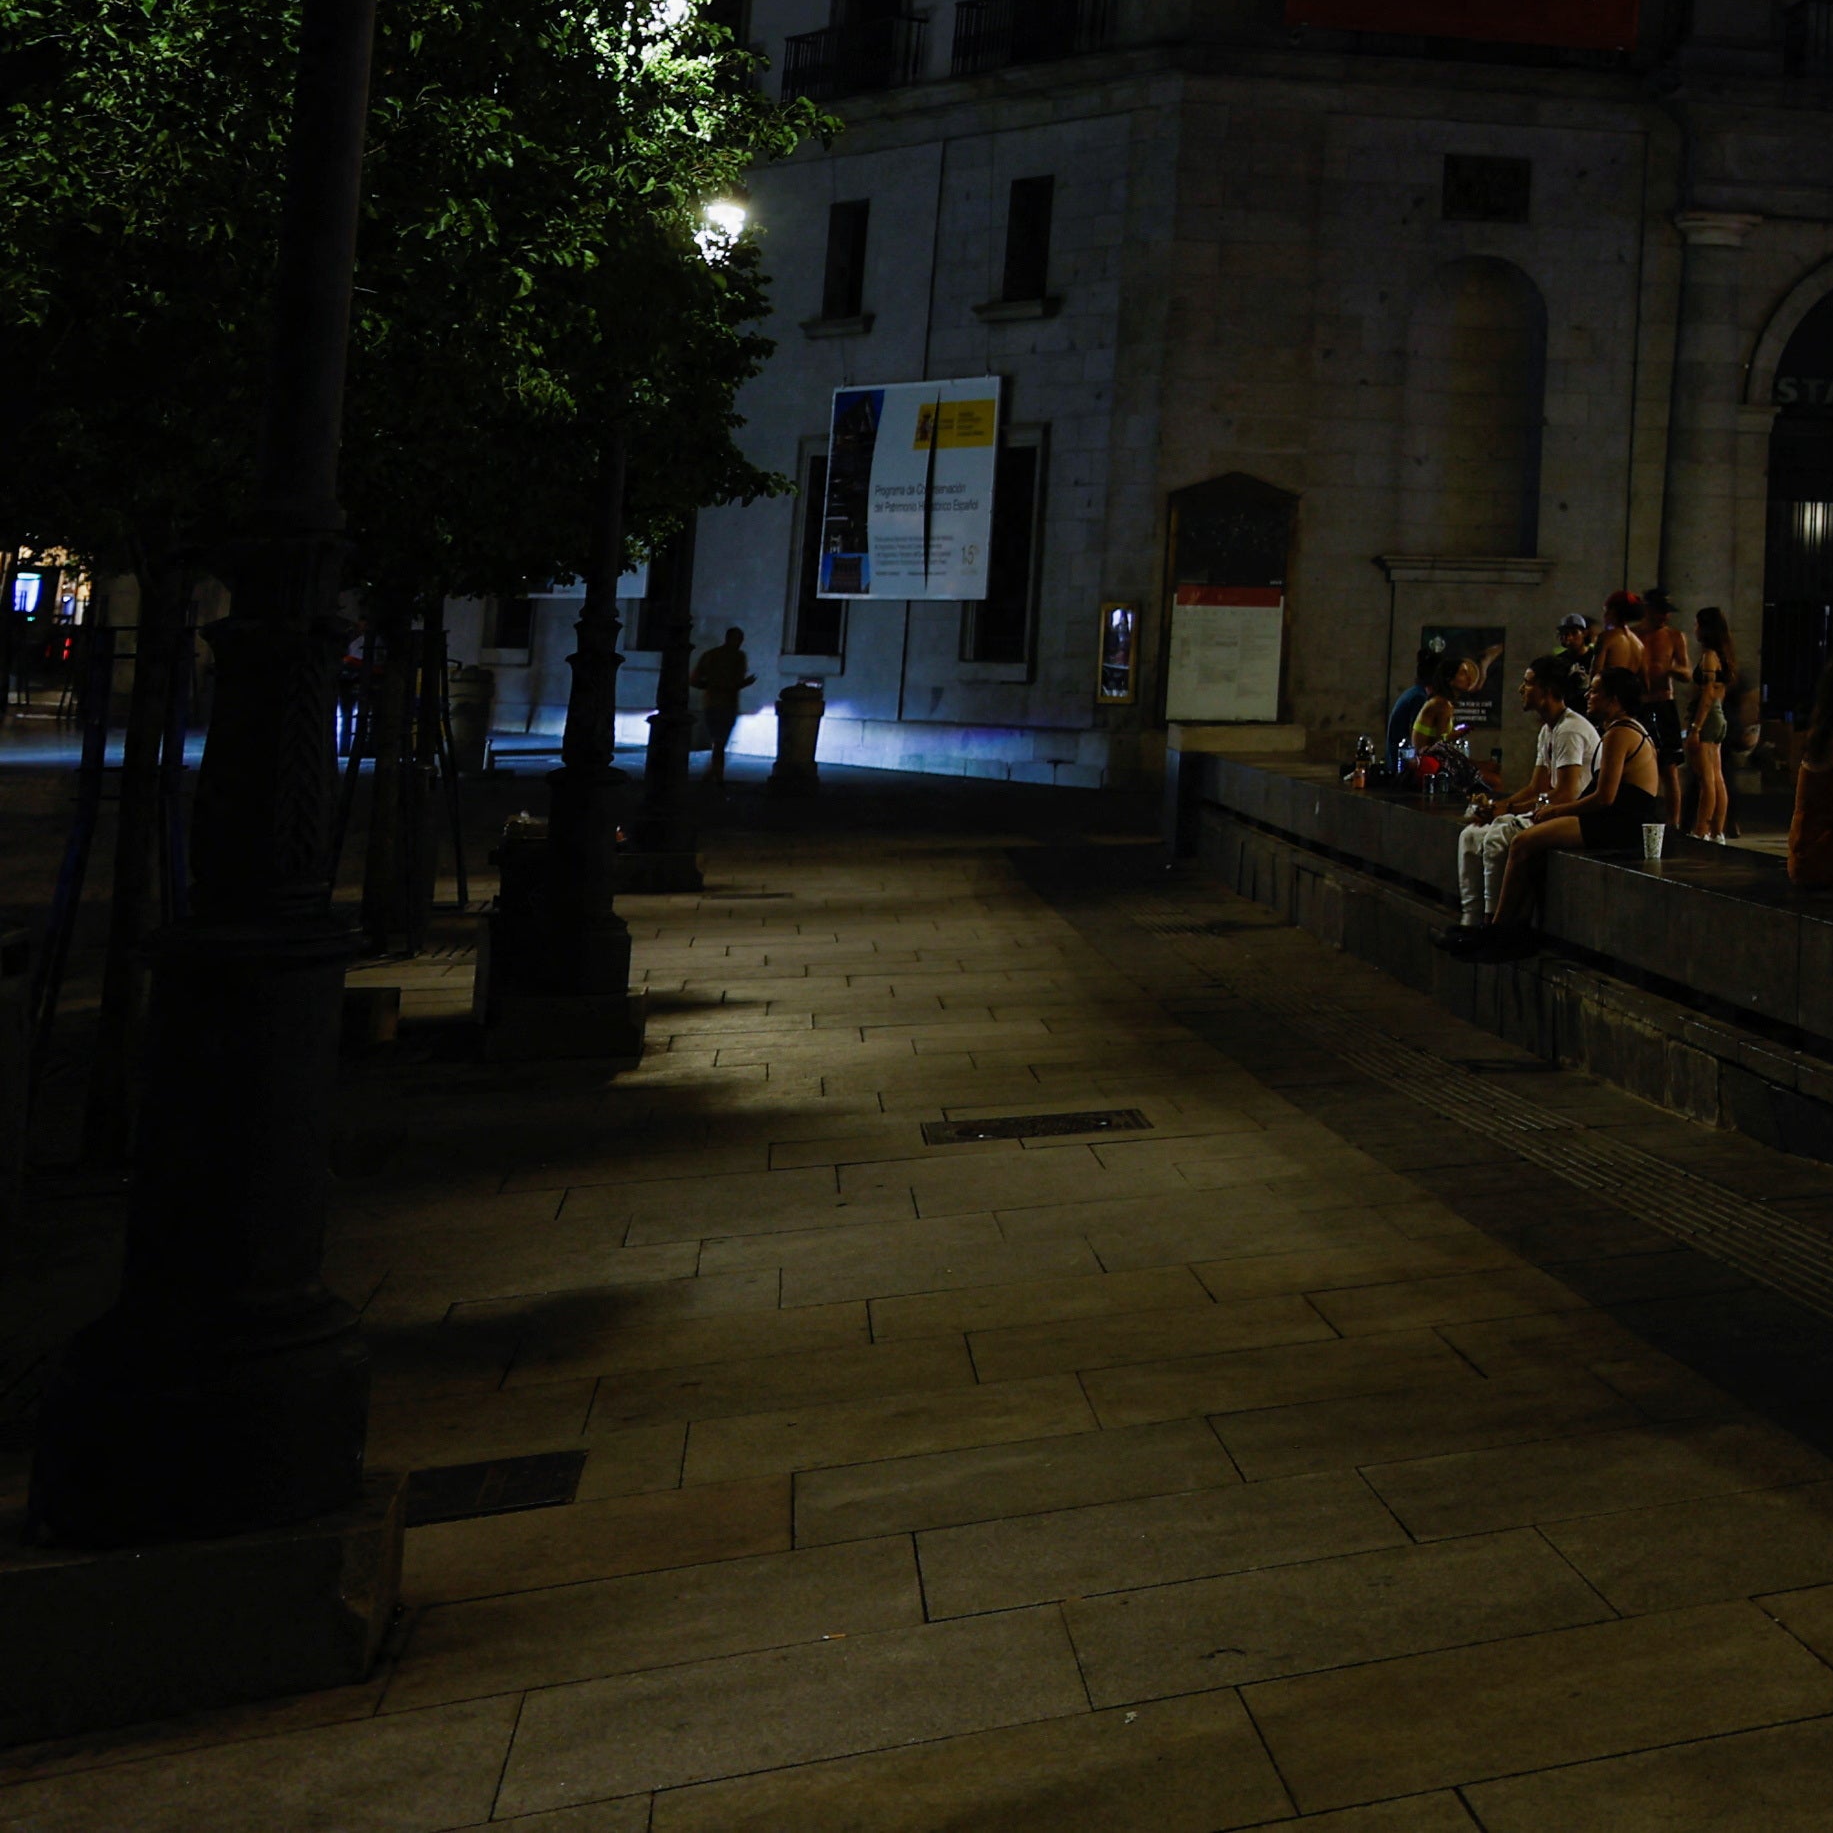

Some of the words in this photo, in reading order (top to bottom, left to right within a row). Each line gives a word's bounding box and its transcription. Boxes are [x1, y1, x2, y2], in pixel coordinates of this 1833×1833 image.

[875, 485, 904, 498] Programa
[906, 485, 915, 495] de
[874, 502, 883, 513] del
[885, 501, 917, 513] Patrimonio
[953, 498, 978, 511] Español
